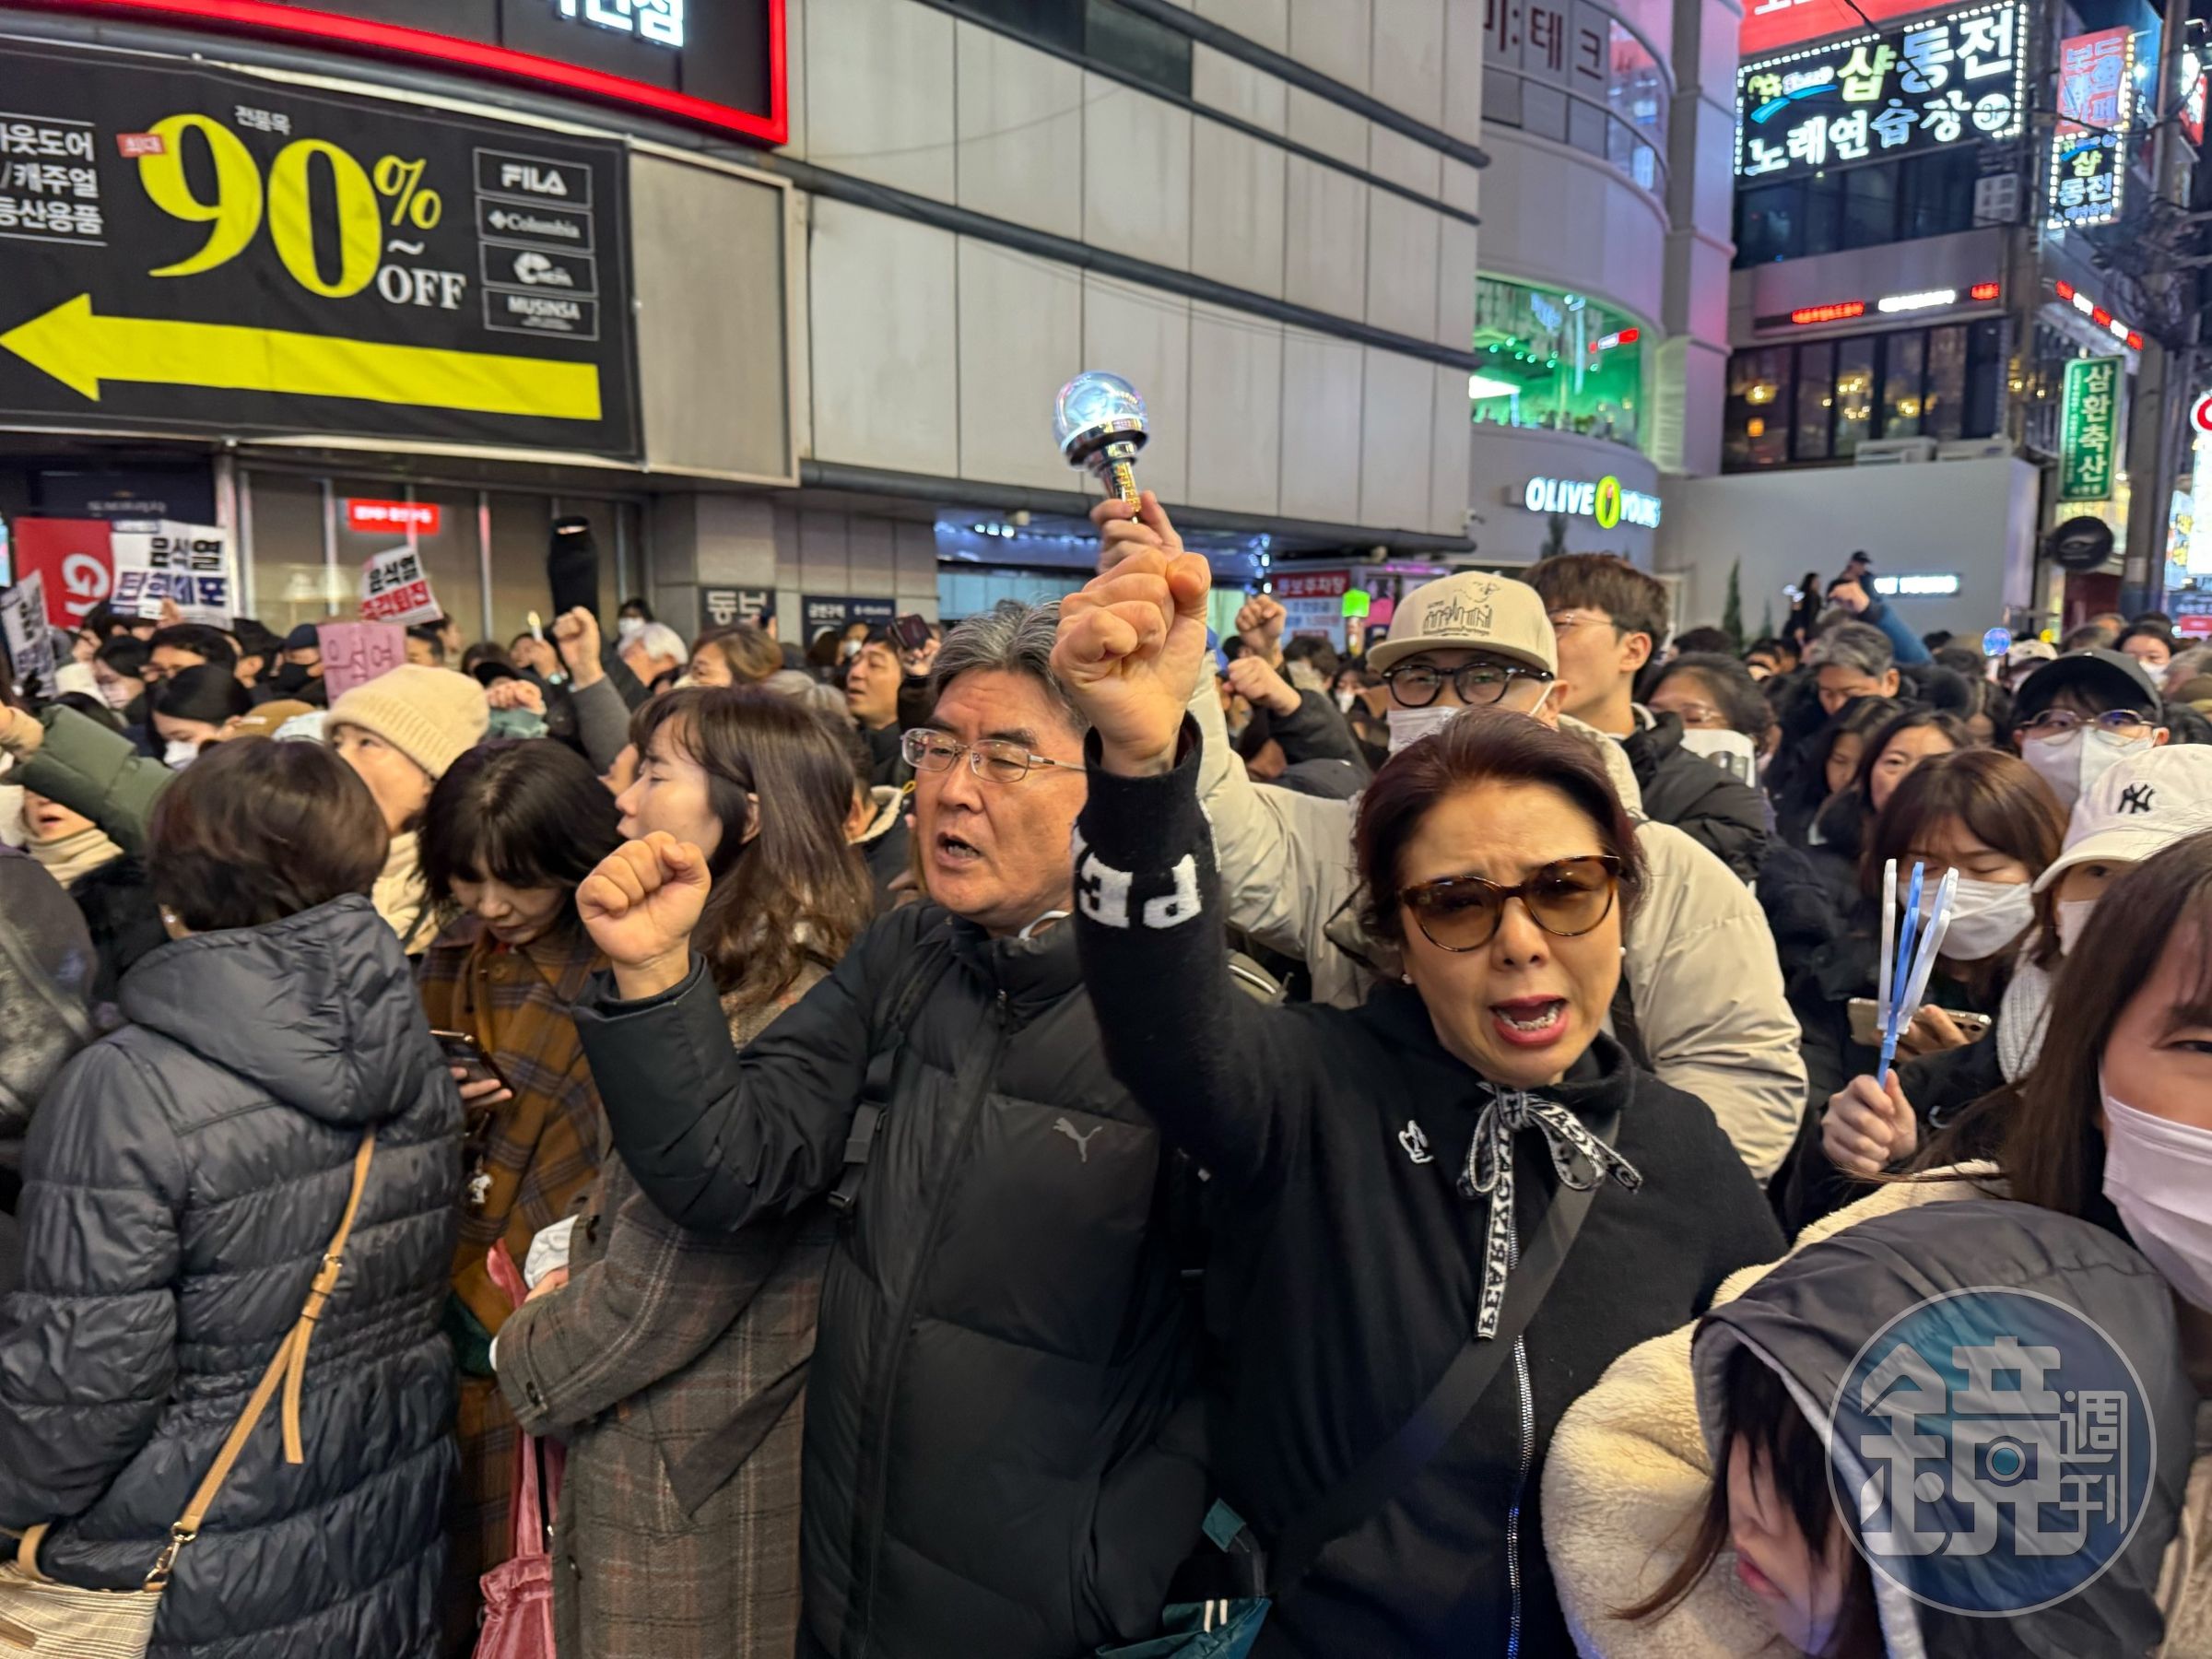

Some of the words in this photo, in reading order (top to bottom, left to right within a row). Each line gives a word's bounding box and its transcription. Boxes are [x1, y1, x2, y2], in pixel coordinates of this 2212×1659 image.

[1897, 8, 2014, 94] 동전
[1744, 90, 1971, 176] 노래연습장
[501, 163, 568, 195] FILA
[376, 265, 466, 310] OFF
[508, 295, 582, 320] MUSINSA
[2077, 364, 2112, 483] 삼환축산
[1525, 477, 1596, 516] OLIVE
[2118, 783, 2154, 814] NY
